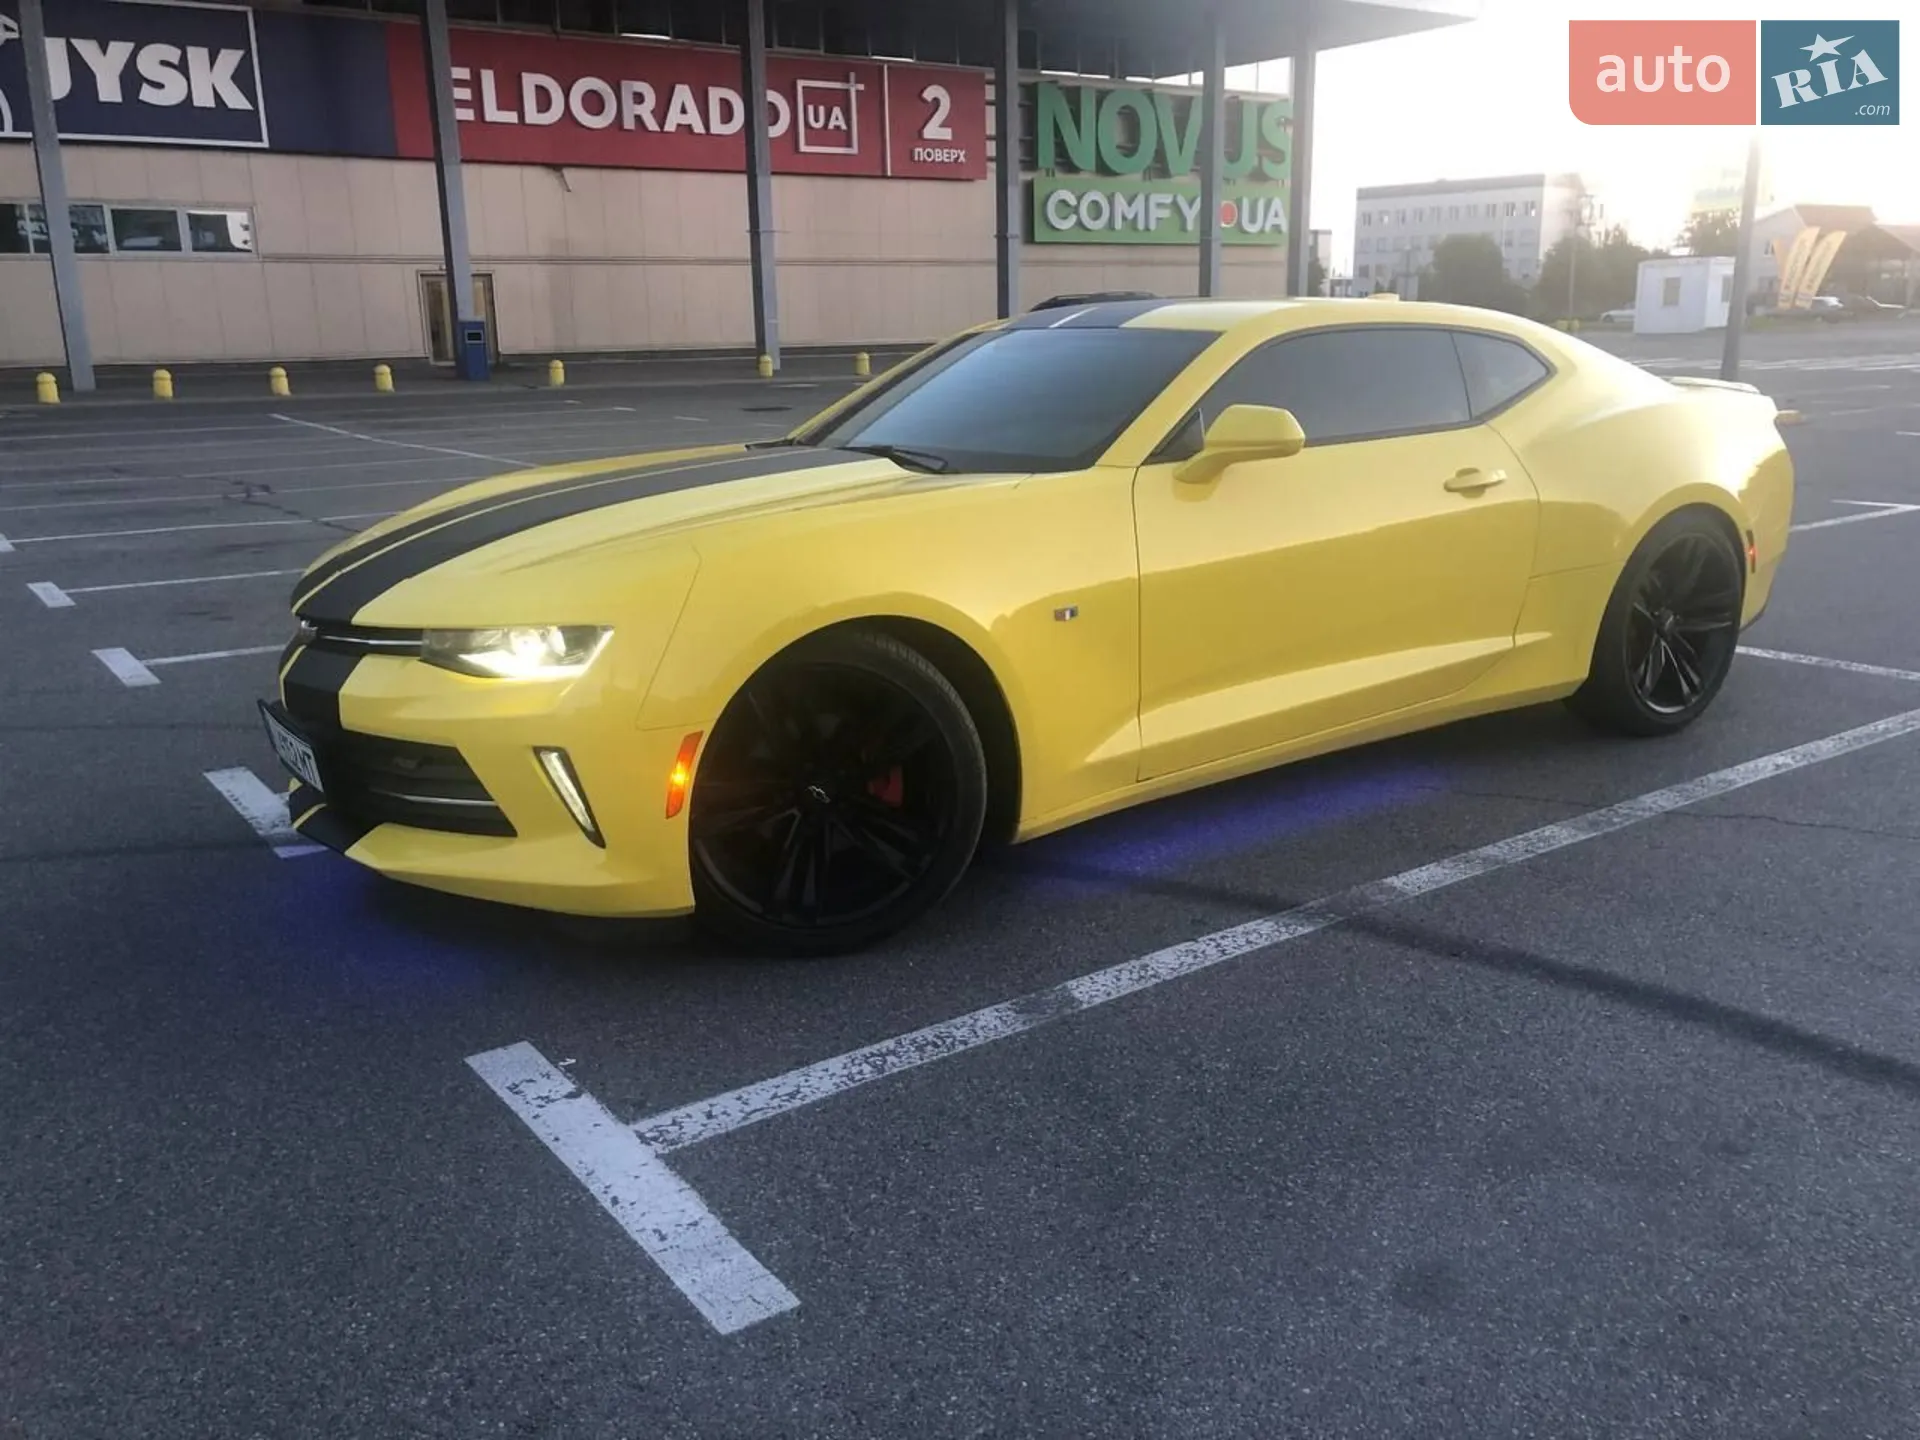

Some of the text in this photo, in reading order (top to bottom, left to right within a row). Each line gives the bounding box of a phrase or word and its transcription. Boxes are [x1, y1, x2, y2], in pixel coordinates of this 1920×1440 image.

[44, 37, 254, 110] JYSK
[450, 66, 848, 138] ELDORADO UA
[920, 84, 953, 140] 2
[1037, 80, 1293, 180] NOVUS
[914, 147, 966, 163] ПОВЕРХ
